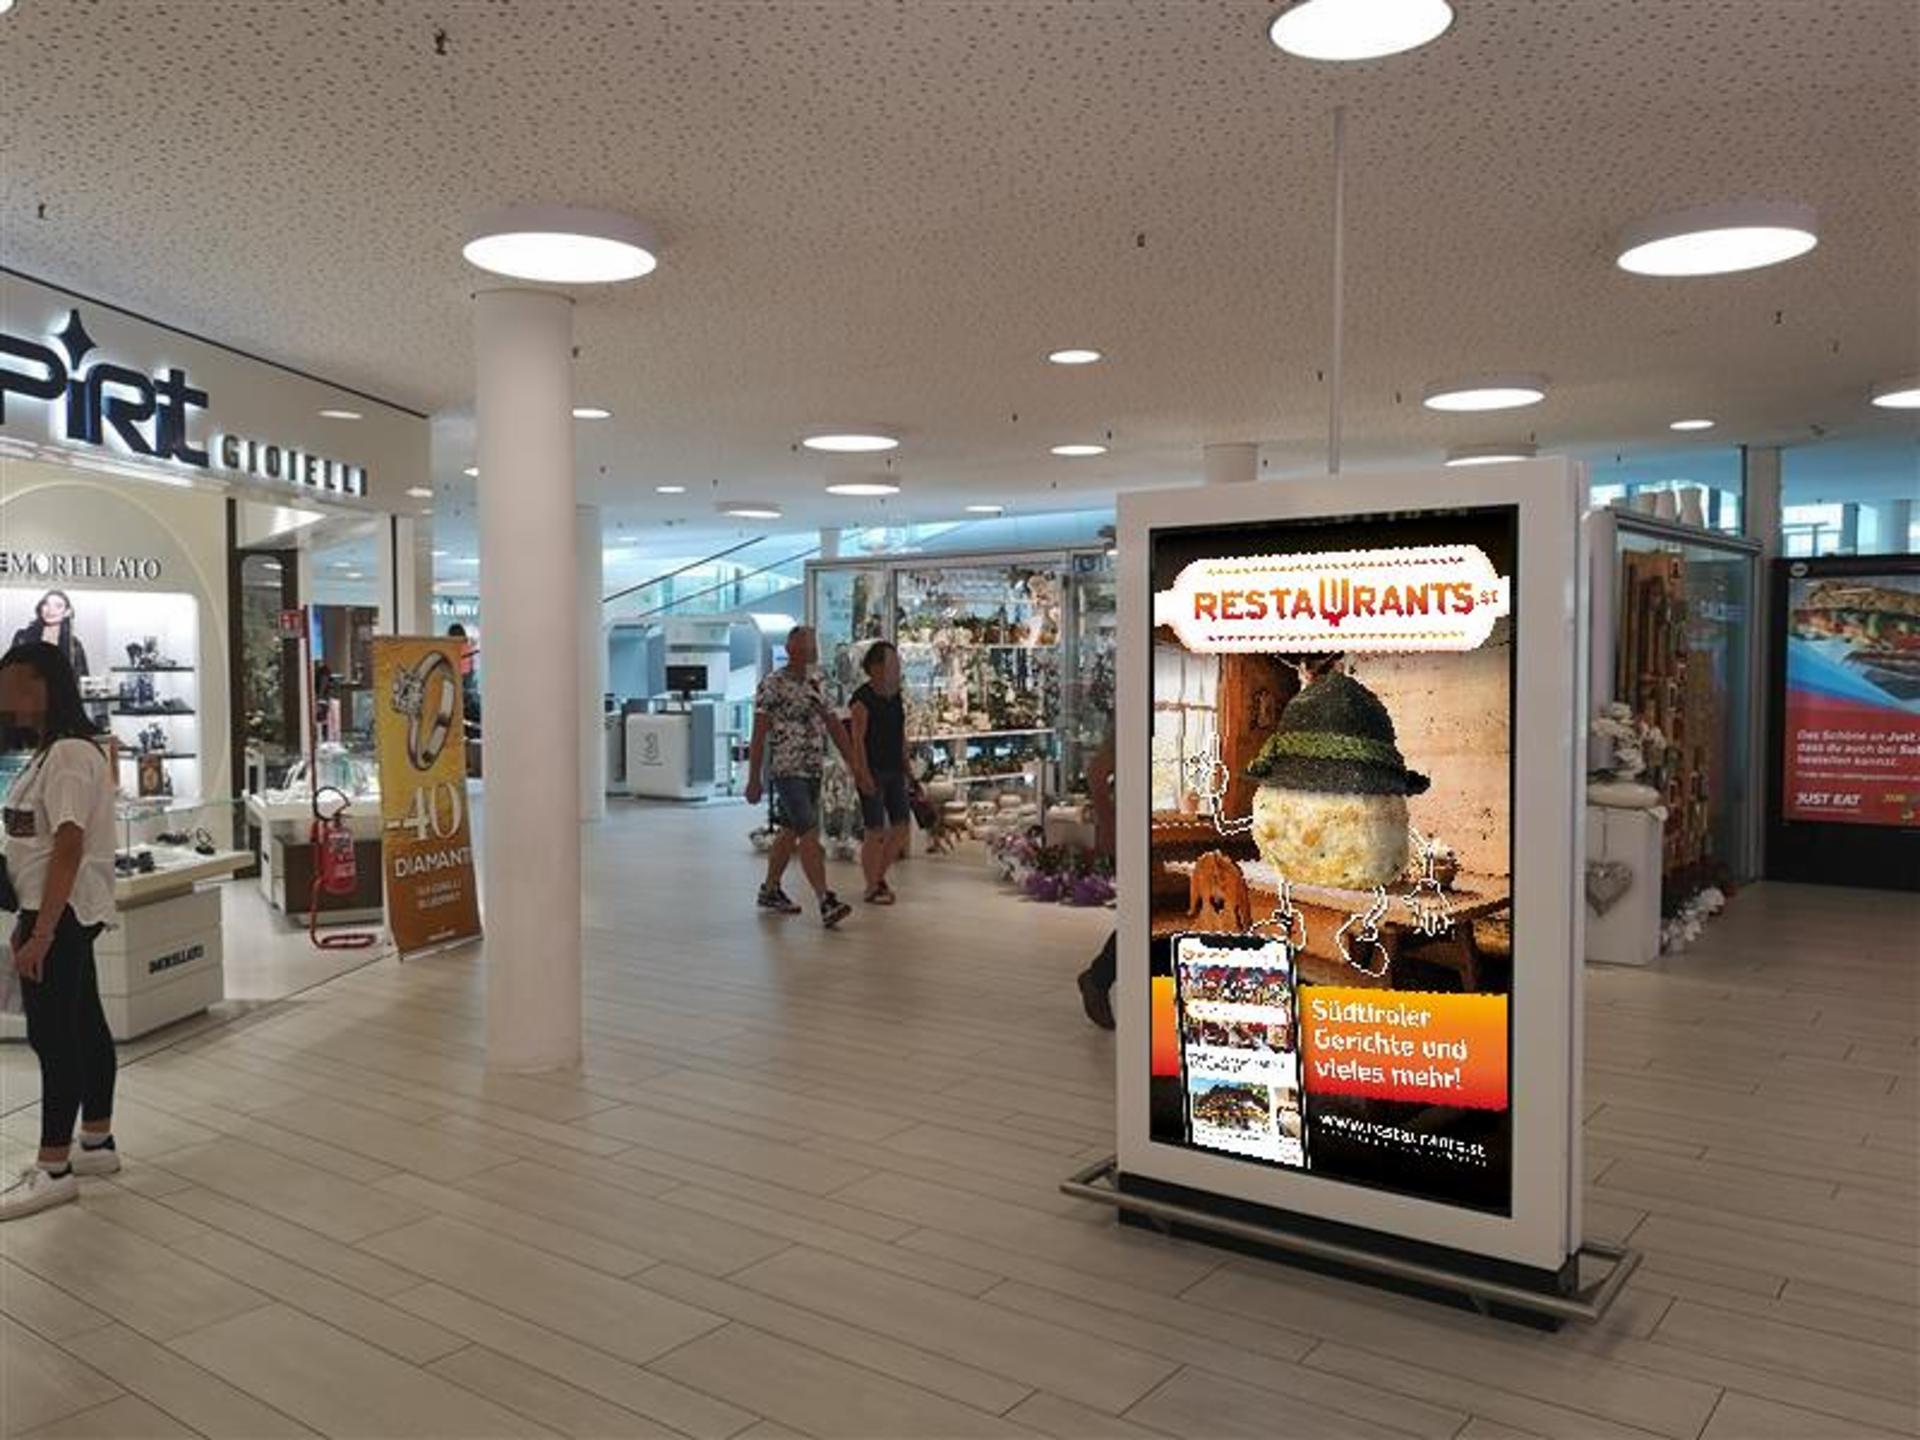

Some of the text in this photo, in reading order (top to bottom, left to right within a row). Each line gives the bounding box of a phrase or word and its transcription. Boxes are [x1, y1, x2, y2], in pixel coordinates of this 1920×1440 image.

[222, 434, 368, 496] GIOIELLI
[9, 551, 162, 581] MORELLATO
[386, 782, 463, 841] -40
[1796, 792, 1861, 806] JUST EAT
[1311, 997, 1432, 1029] Südtiroler
[1313, 1027, 1469, 1062] Gerichte und
[1314, 1057, 1386, 1085] vieles
[1390, 1065, 1463, 1091] mehr!
